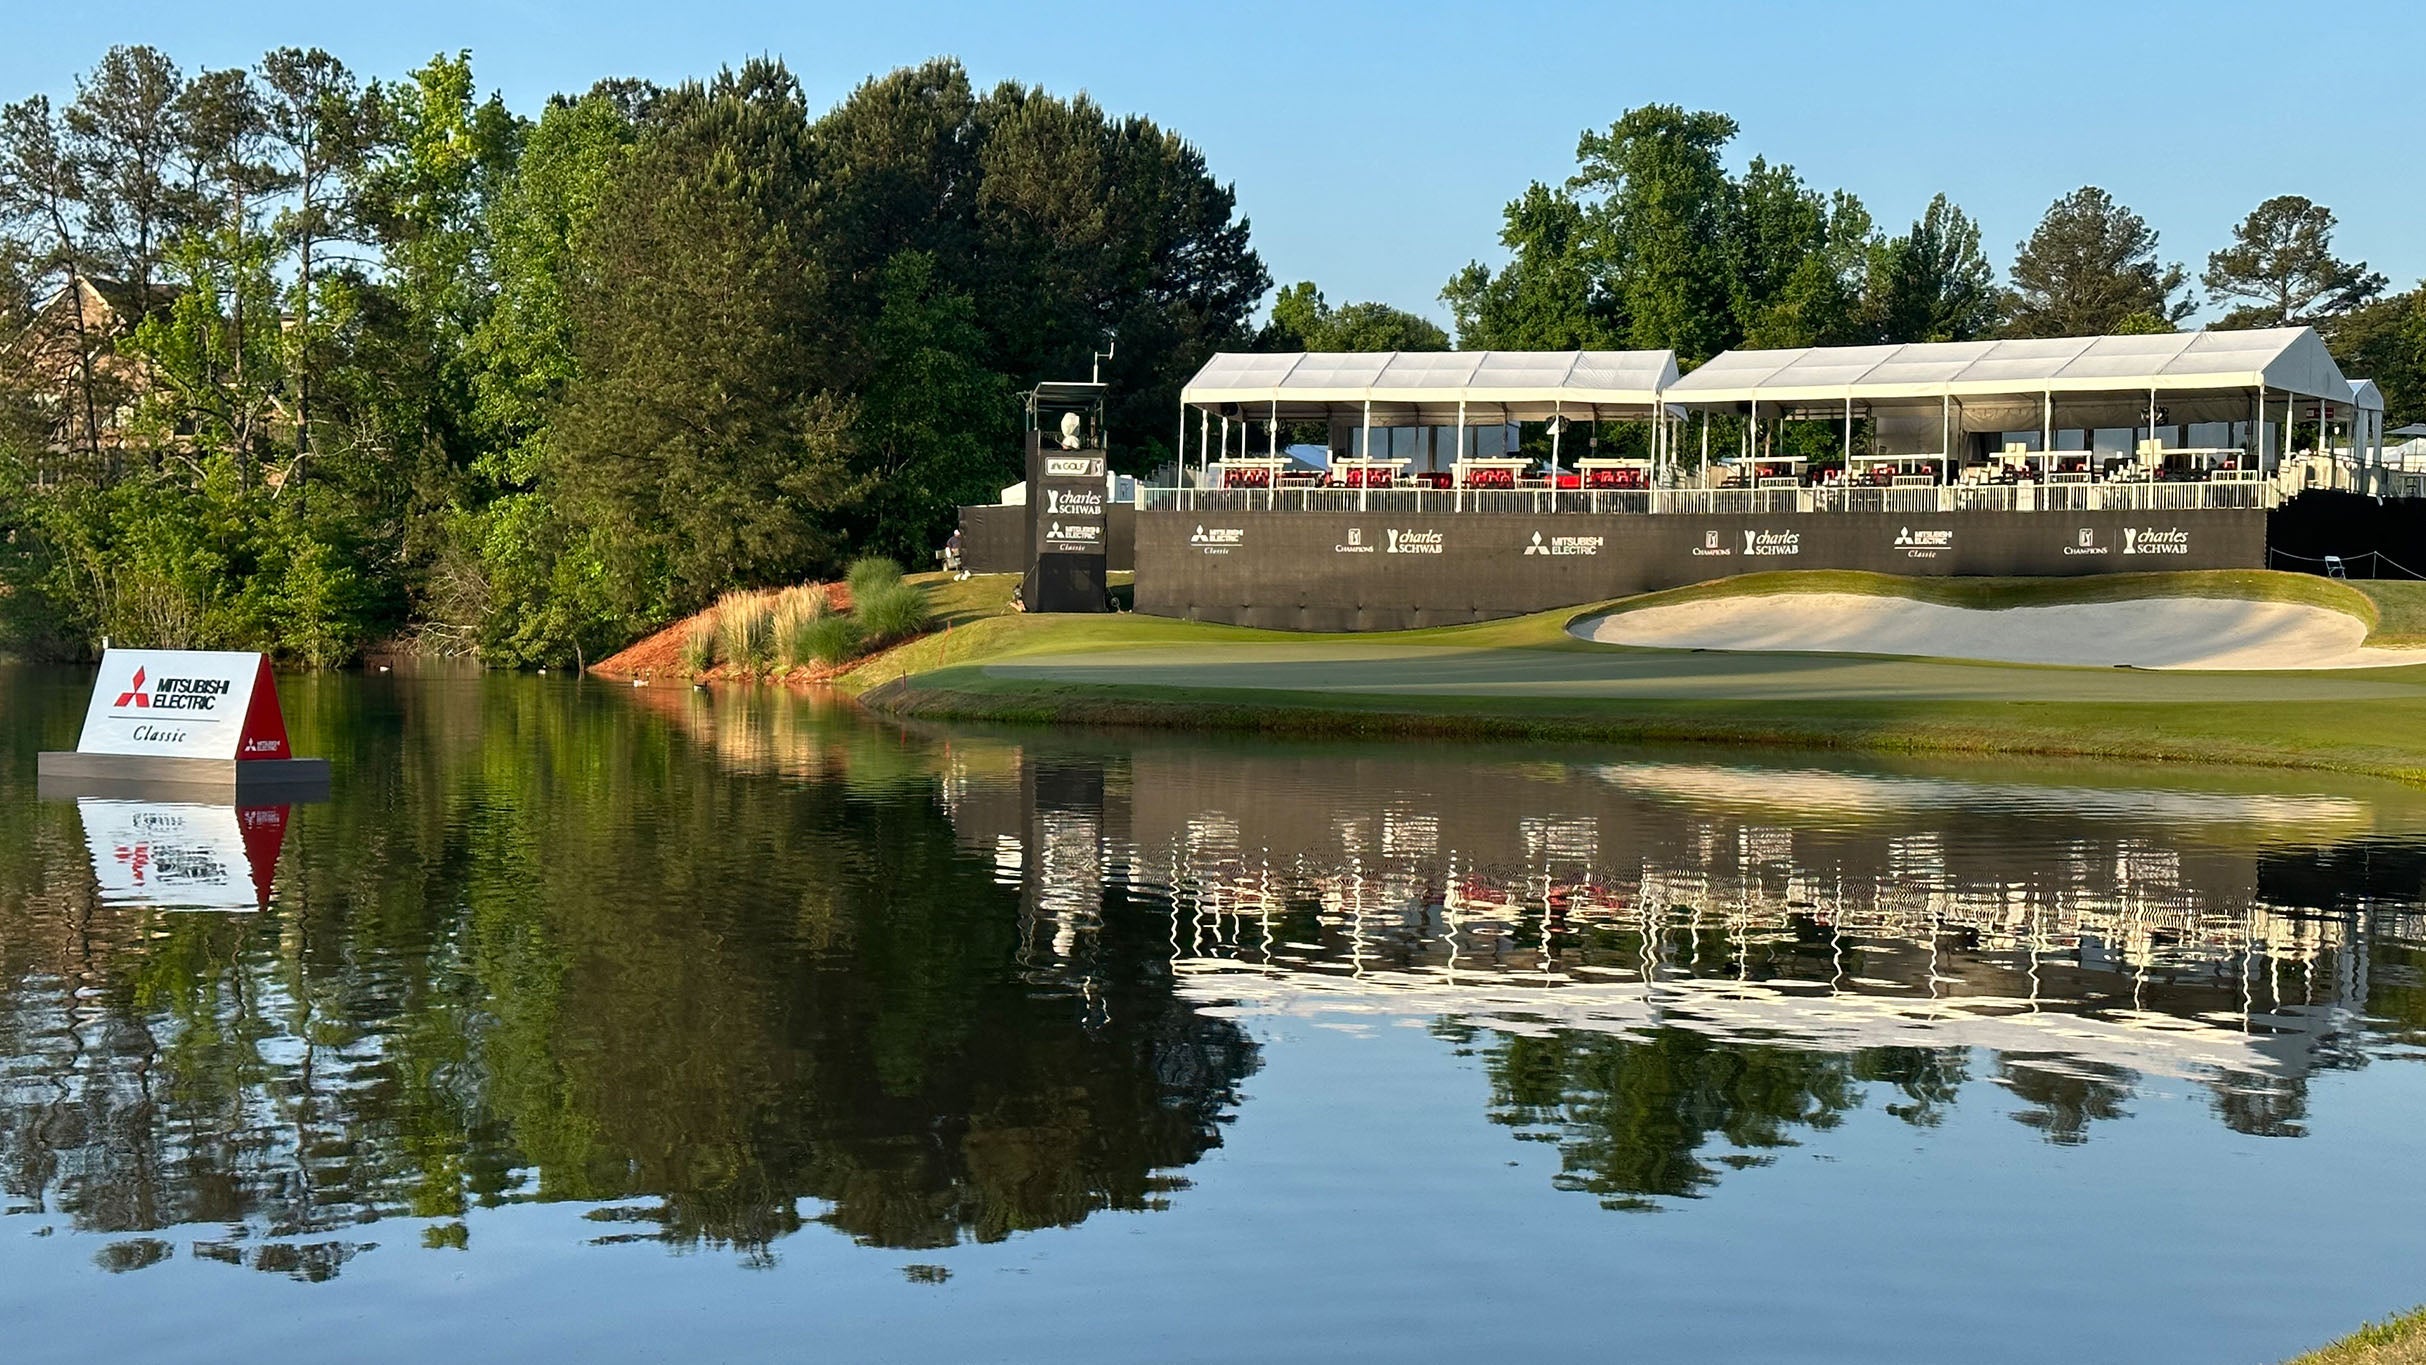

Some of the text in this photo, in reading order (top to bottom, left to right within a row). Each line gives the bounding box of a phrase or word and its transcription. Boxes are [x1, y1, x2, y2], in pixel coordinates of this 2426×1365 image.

[1060, 490, 1101, 504] charles
[1059, 505, 1101, 514] SCHWAB
[1399, 529, 1443, 543] charles
[1756, 530, 1800, 544] charles
[2138, 527, 2188, 543] charles
[1552, 537, 1603, 546] MITSUBISHI
[1399, 544, 1443, 553] SCHWAB
[1552, 546, 1597, 555] ELECTRIC
[1755, 545, 1799, 555] SCHWAB
[2063, 546, 2108, 555] CHAMPIONS
[2137, 544, 2188, 554] SCHWAB
[1908, 550, 1937, 558] Classic
[157, 678, 231, 695] MITSUBISHI
[152, 694, 216, 710] ELECTRIC
[133, 725, 187, 743] Classic
